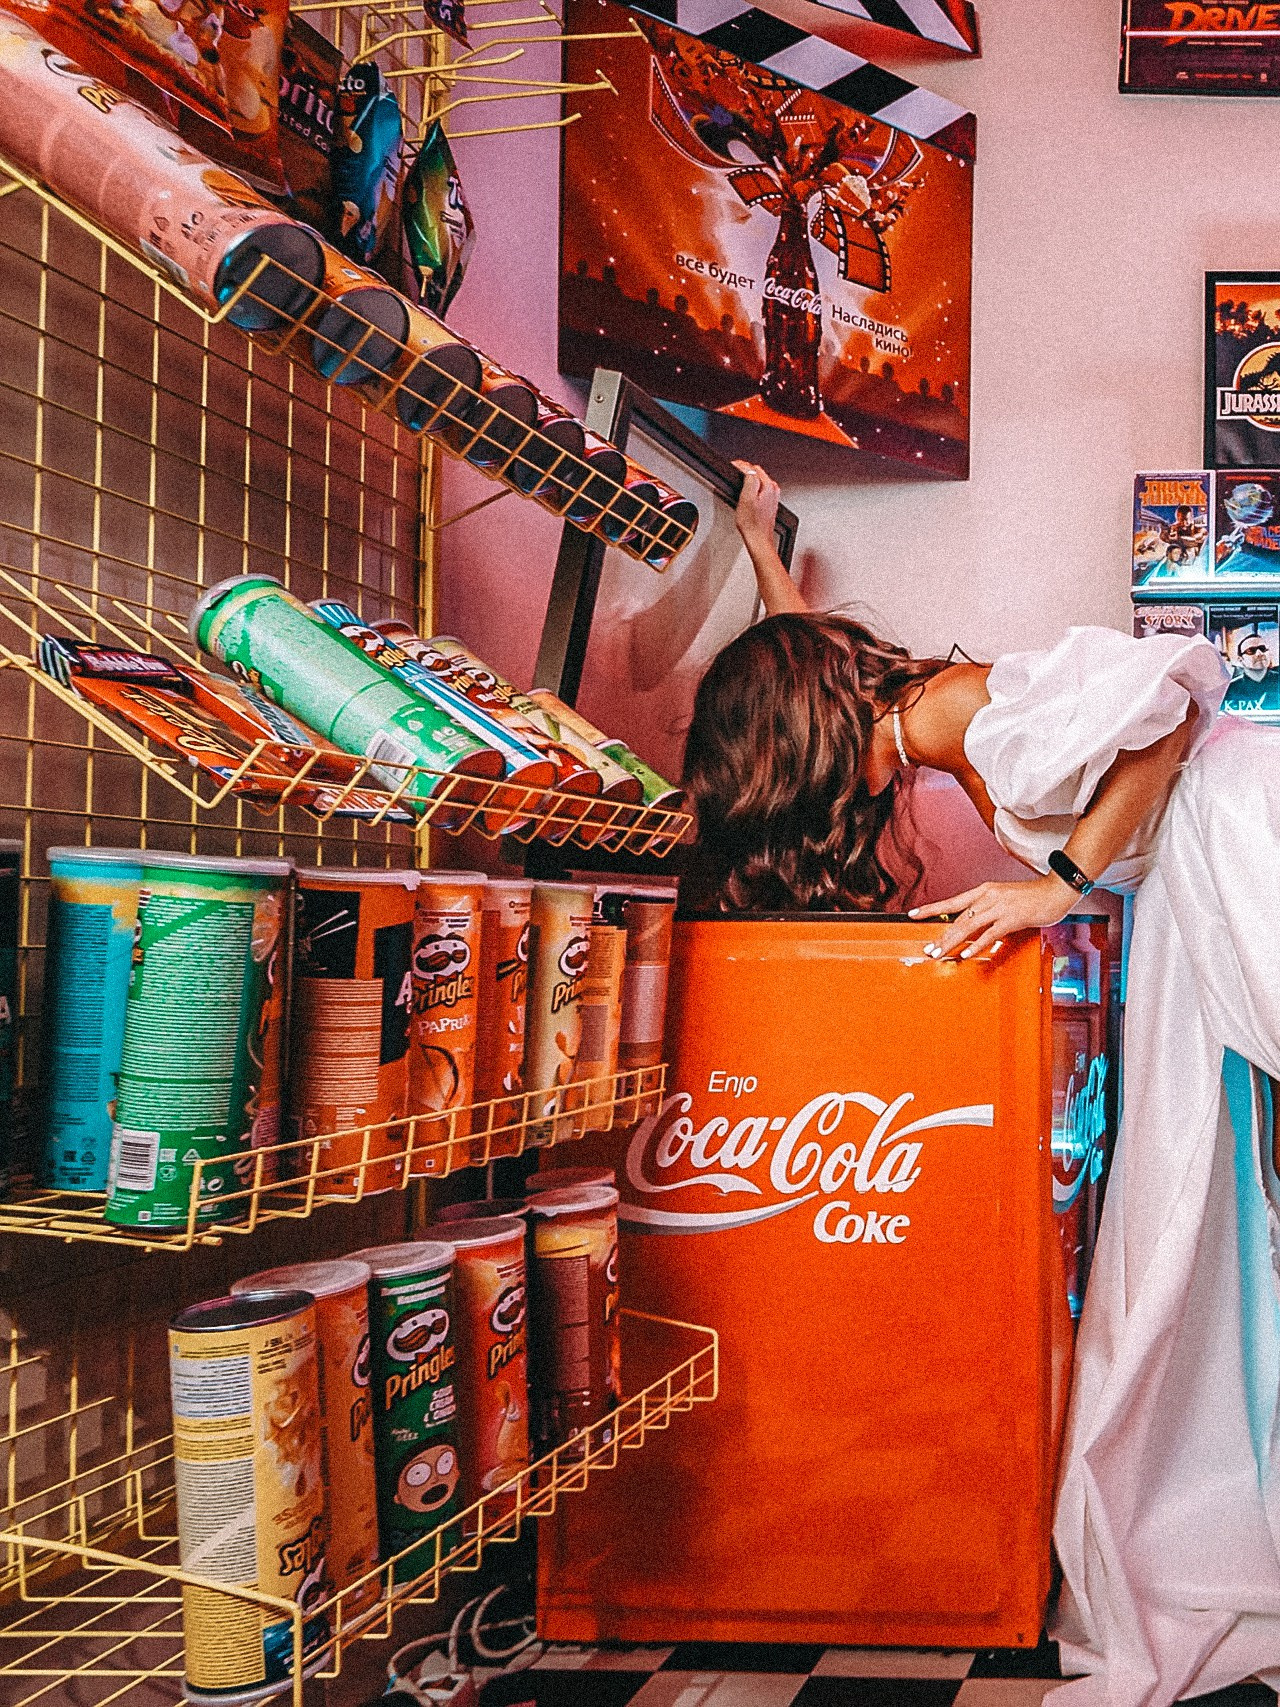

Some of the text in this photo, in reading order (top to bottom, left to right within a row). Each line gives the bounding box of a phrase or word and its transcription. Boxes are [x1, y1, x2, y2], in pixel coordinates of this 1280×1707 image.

[708, 258, 756, 291] будет
[831, 303, 909, 343] Насладись
[1223, 692, 1266, 712] K-PAX
[411, 974, 472, 1014] Pringle
[626, 1091, 925, 1194] Coca-Cola
[813, 1201, 911, 1244] Coke
[385, 1344, 455, 1410] Pringle
